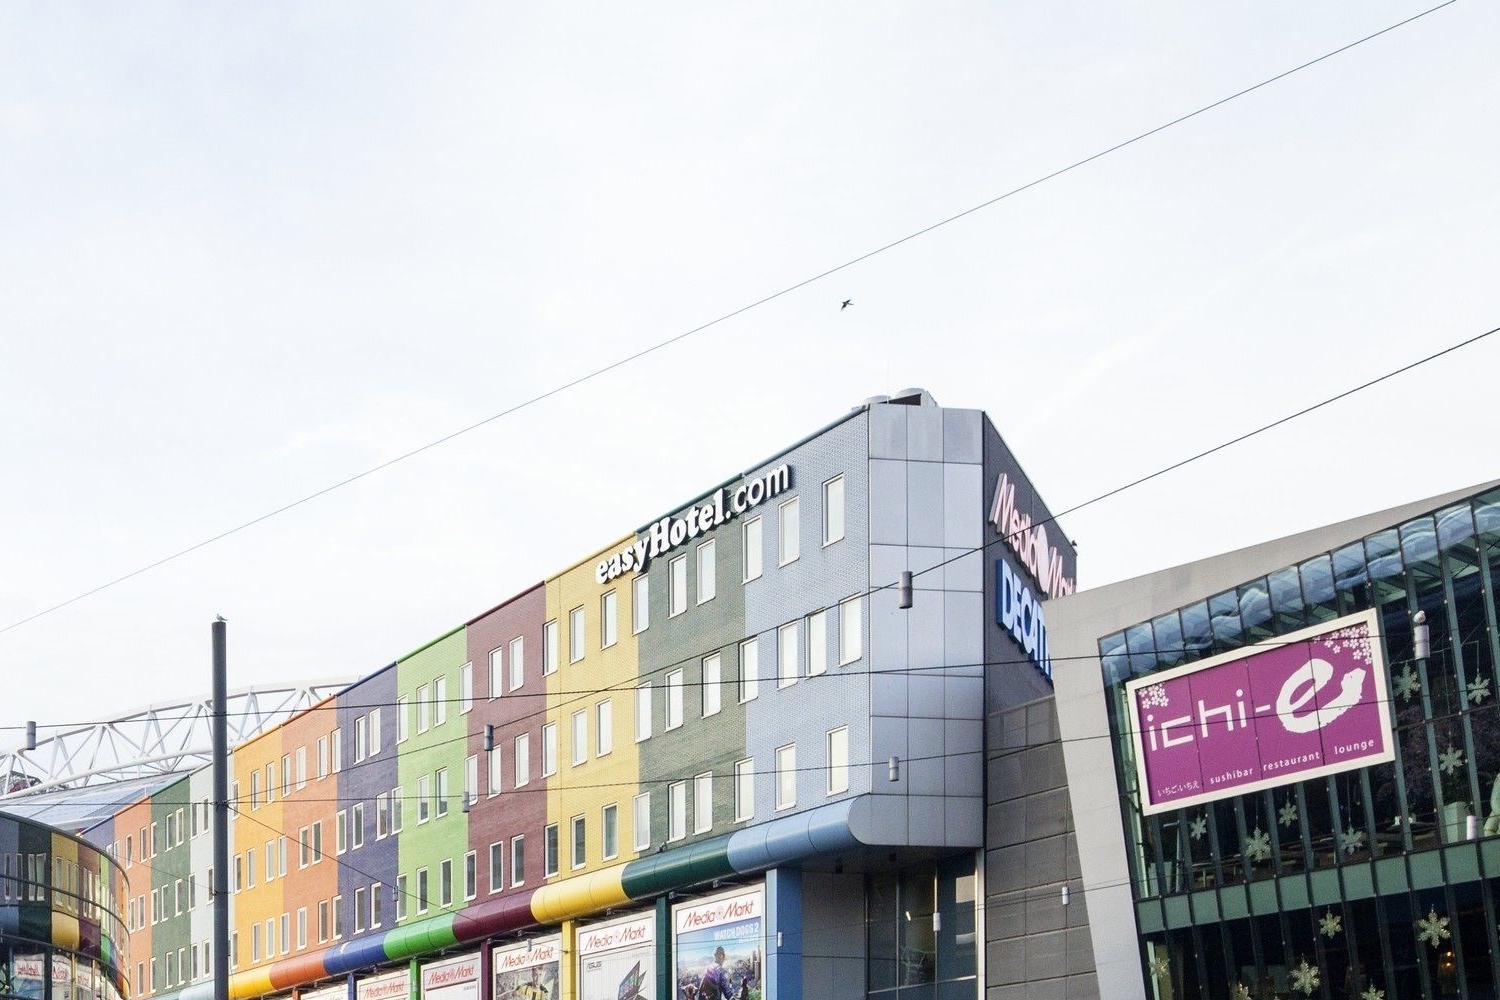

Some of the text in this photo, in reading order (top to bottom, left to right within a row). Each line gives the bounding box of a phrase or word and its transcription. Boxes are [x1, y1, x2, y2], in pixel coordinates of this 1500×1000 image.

[595, 463, 789, 585] easyHotel.com
[1146, 657, 1367, 752] ichi-e
[1209, 738, 1375, 785] sushibar restaurant lounge
[683, 900, 754, 929] Media Markt
[585, 927, 646, 950] Media Markt
[502, 947, 554, 969] Media Markt
[428, 964, 474, 984] Media Markt
